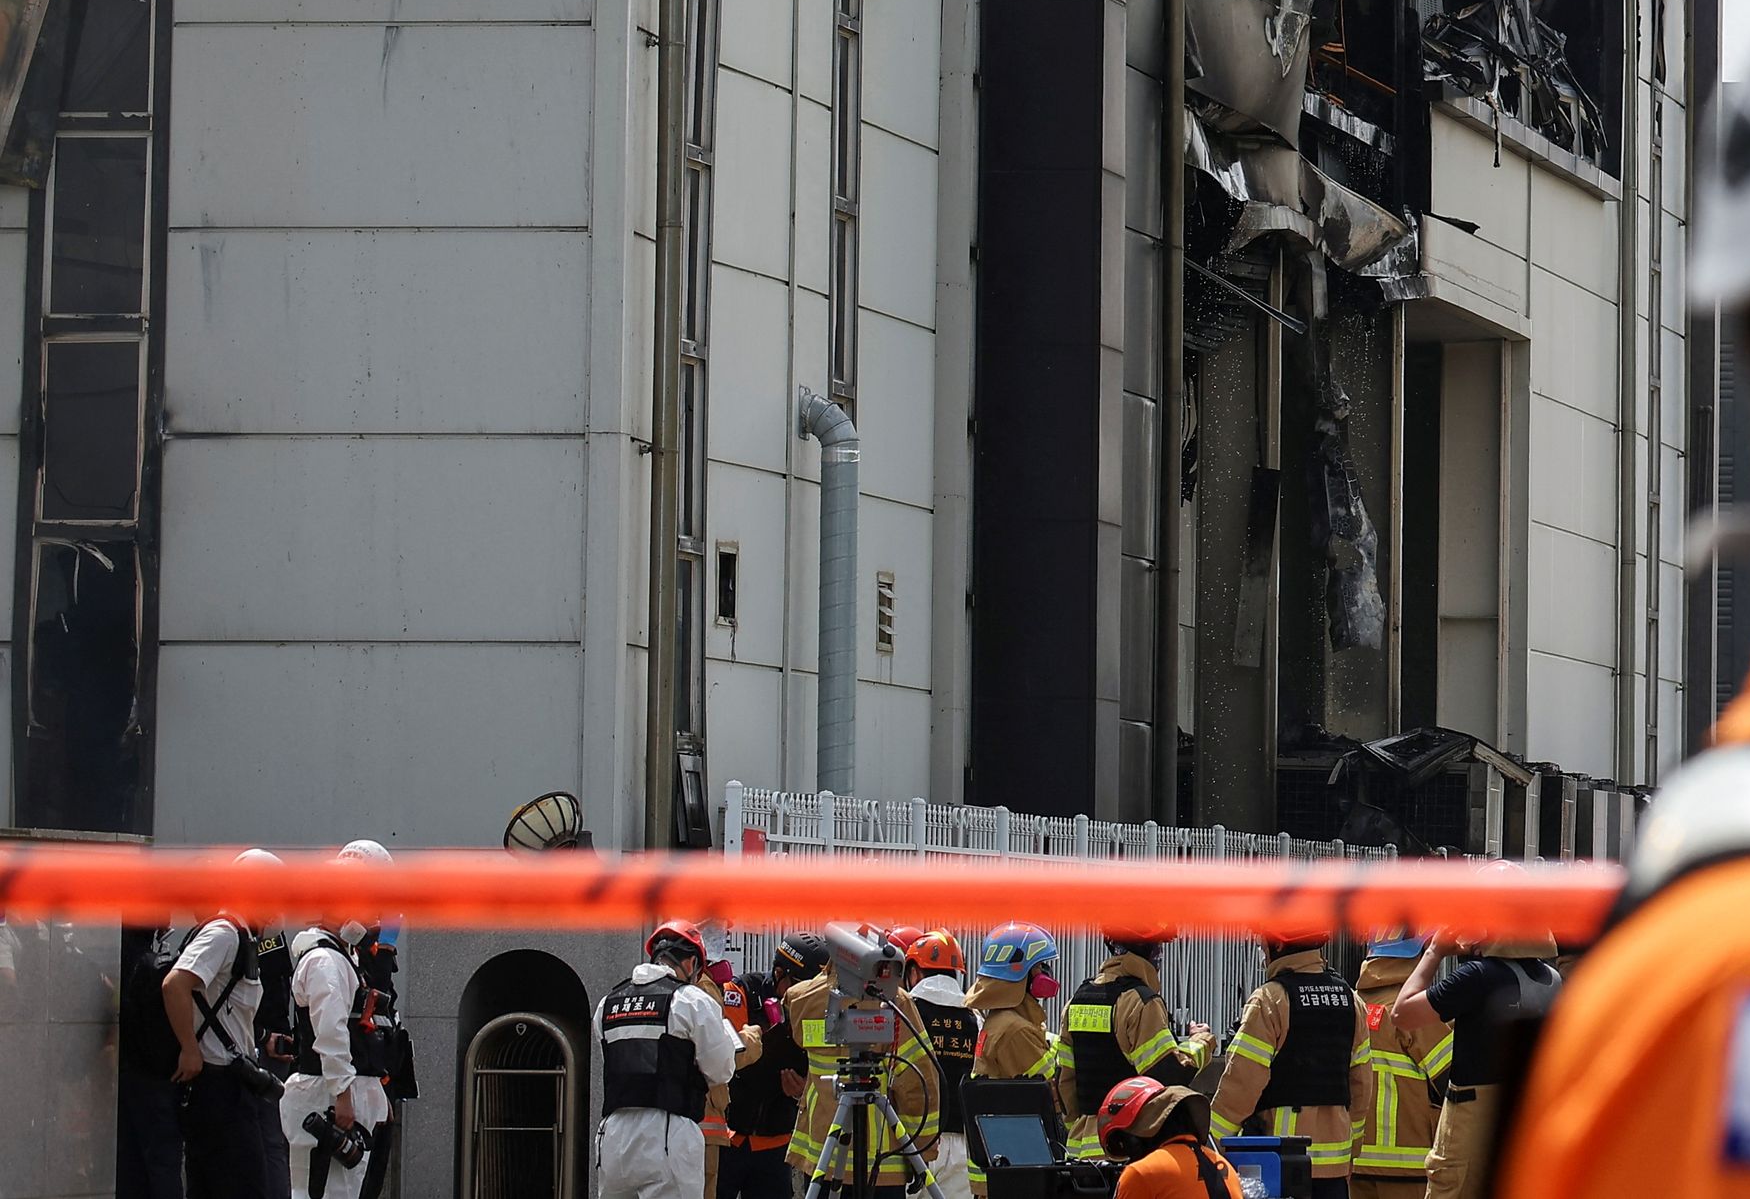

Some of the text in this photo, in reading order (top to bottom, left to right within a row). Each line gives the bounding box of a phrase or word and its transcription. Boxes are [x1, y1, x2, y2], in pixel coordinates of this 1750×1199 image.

[257, 937, 277, 953] LICE
[1300, 993, 1349, 1007] 긴급대응팀
[610, 1001, 656, 1015] 화재조사
[931, 1018, 962, 1030] 소방청
[933, 1035, 972, 1052] 재조사
